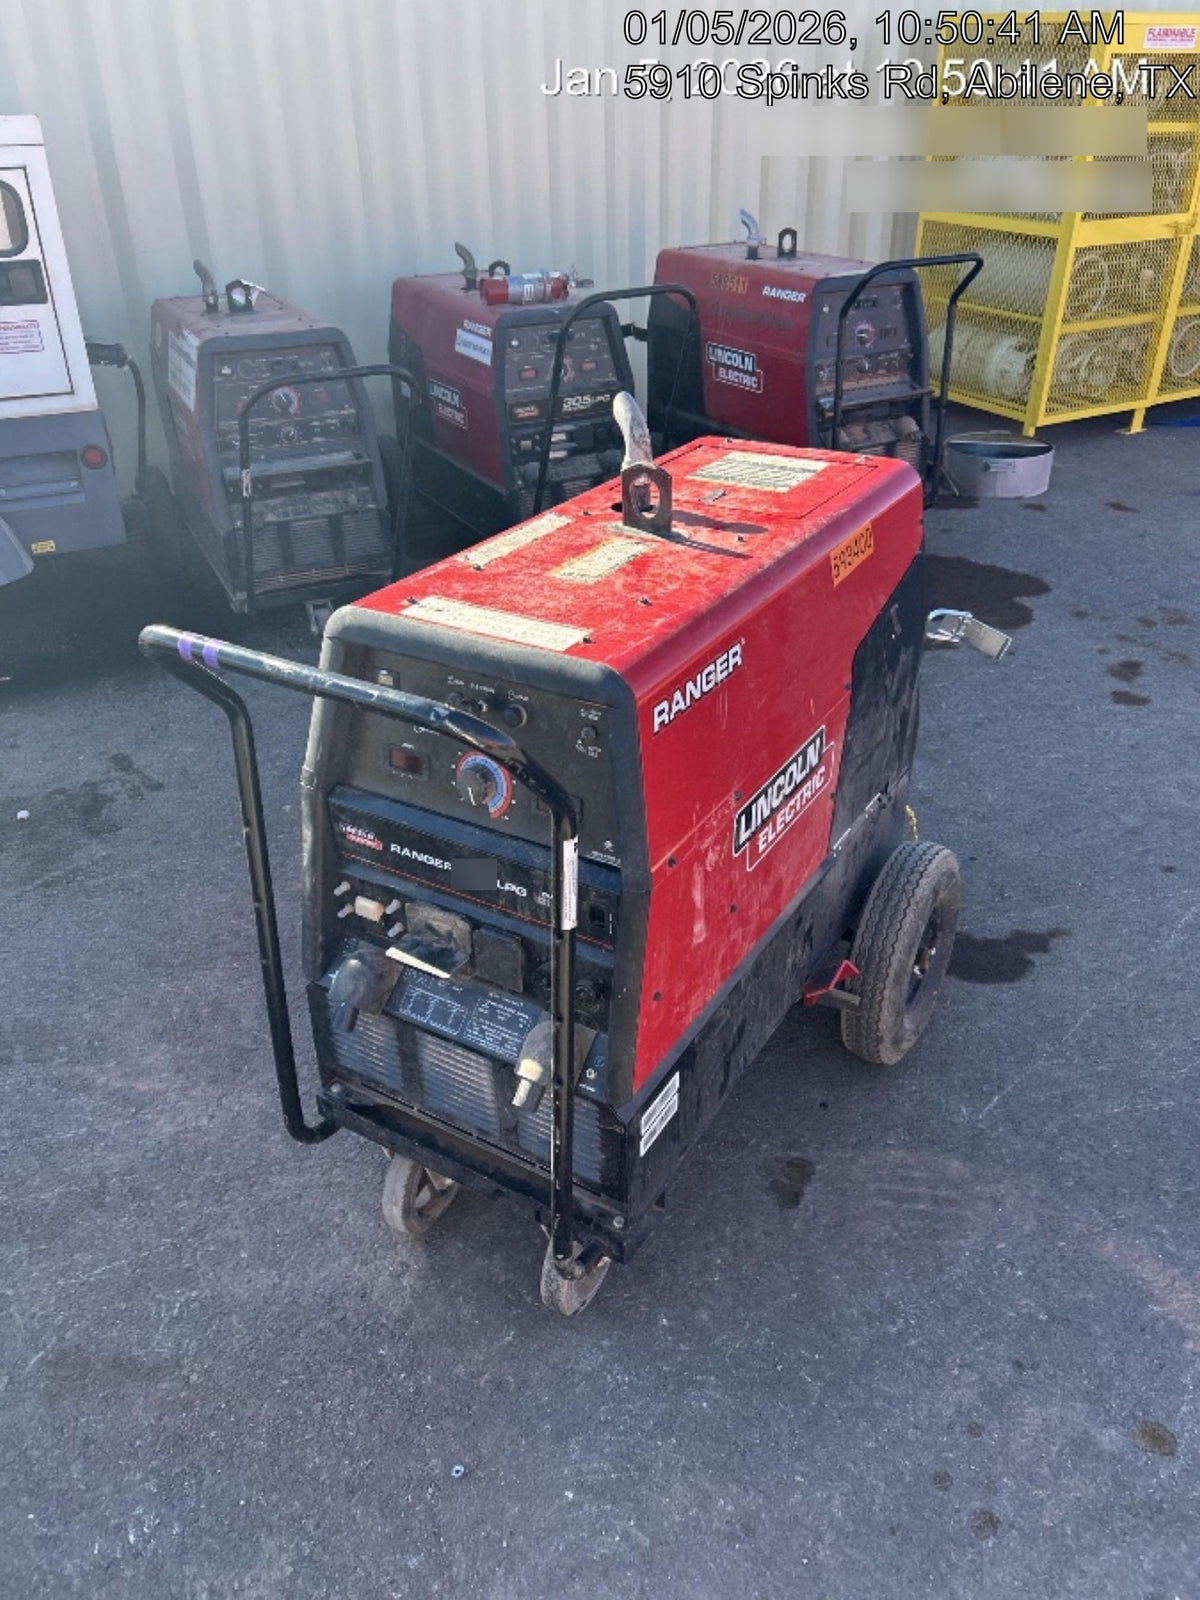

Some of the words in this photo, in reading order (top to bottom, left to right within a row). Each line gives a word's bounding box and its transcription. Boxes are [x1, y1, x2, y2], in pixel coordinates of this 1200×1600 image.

[761, 285, 806, 303] RANGER
[708, 346, 753, 372] LINCOLN
[719, 367, 758, 389] ELECTRIC
[653, 643, 743, 735] RANGER
[737, 736, 822, 846] LINCOLN
[757, 765, 826, 855] ELECTRIC
[390, 842, 452, 871] RANGER
[496, 879, 527, 897] LPG
